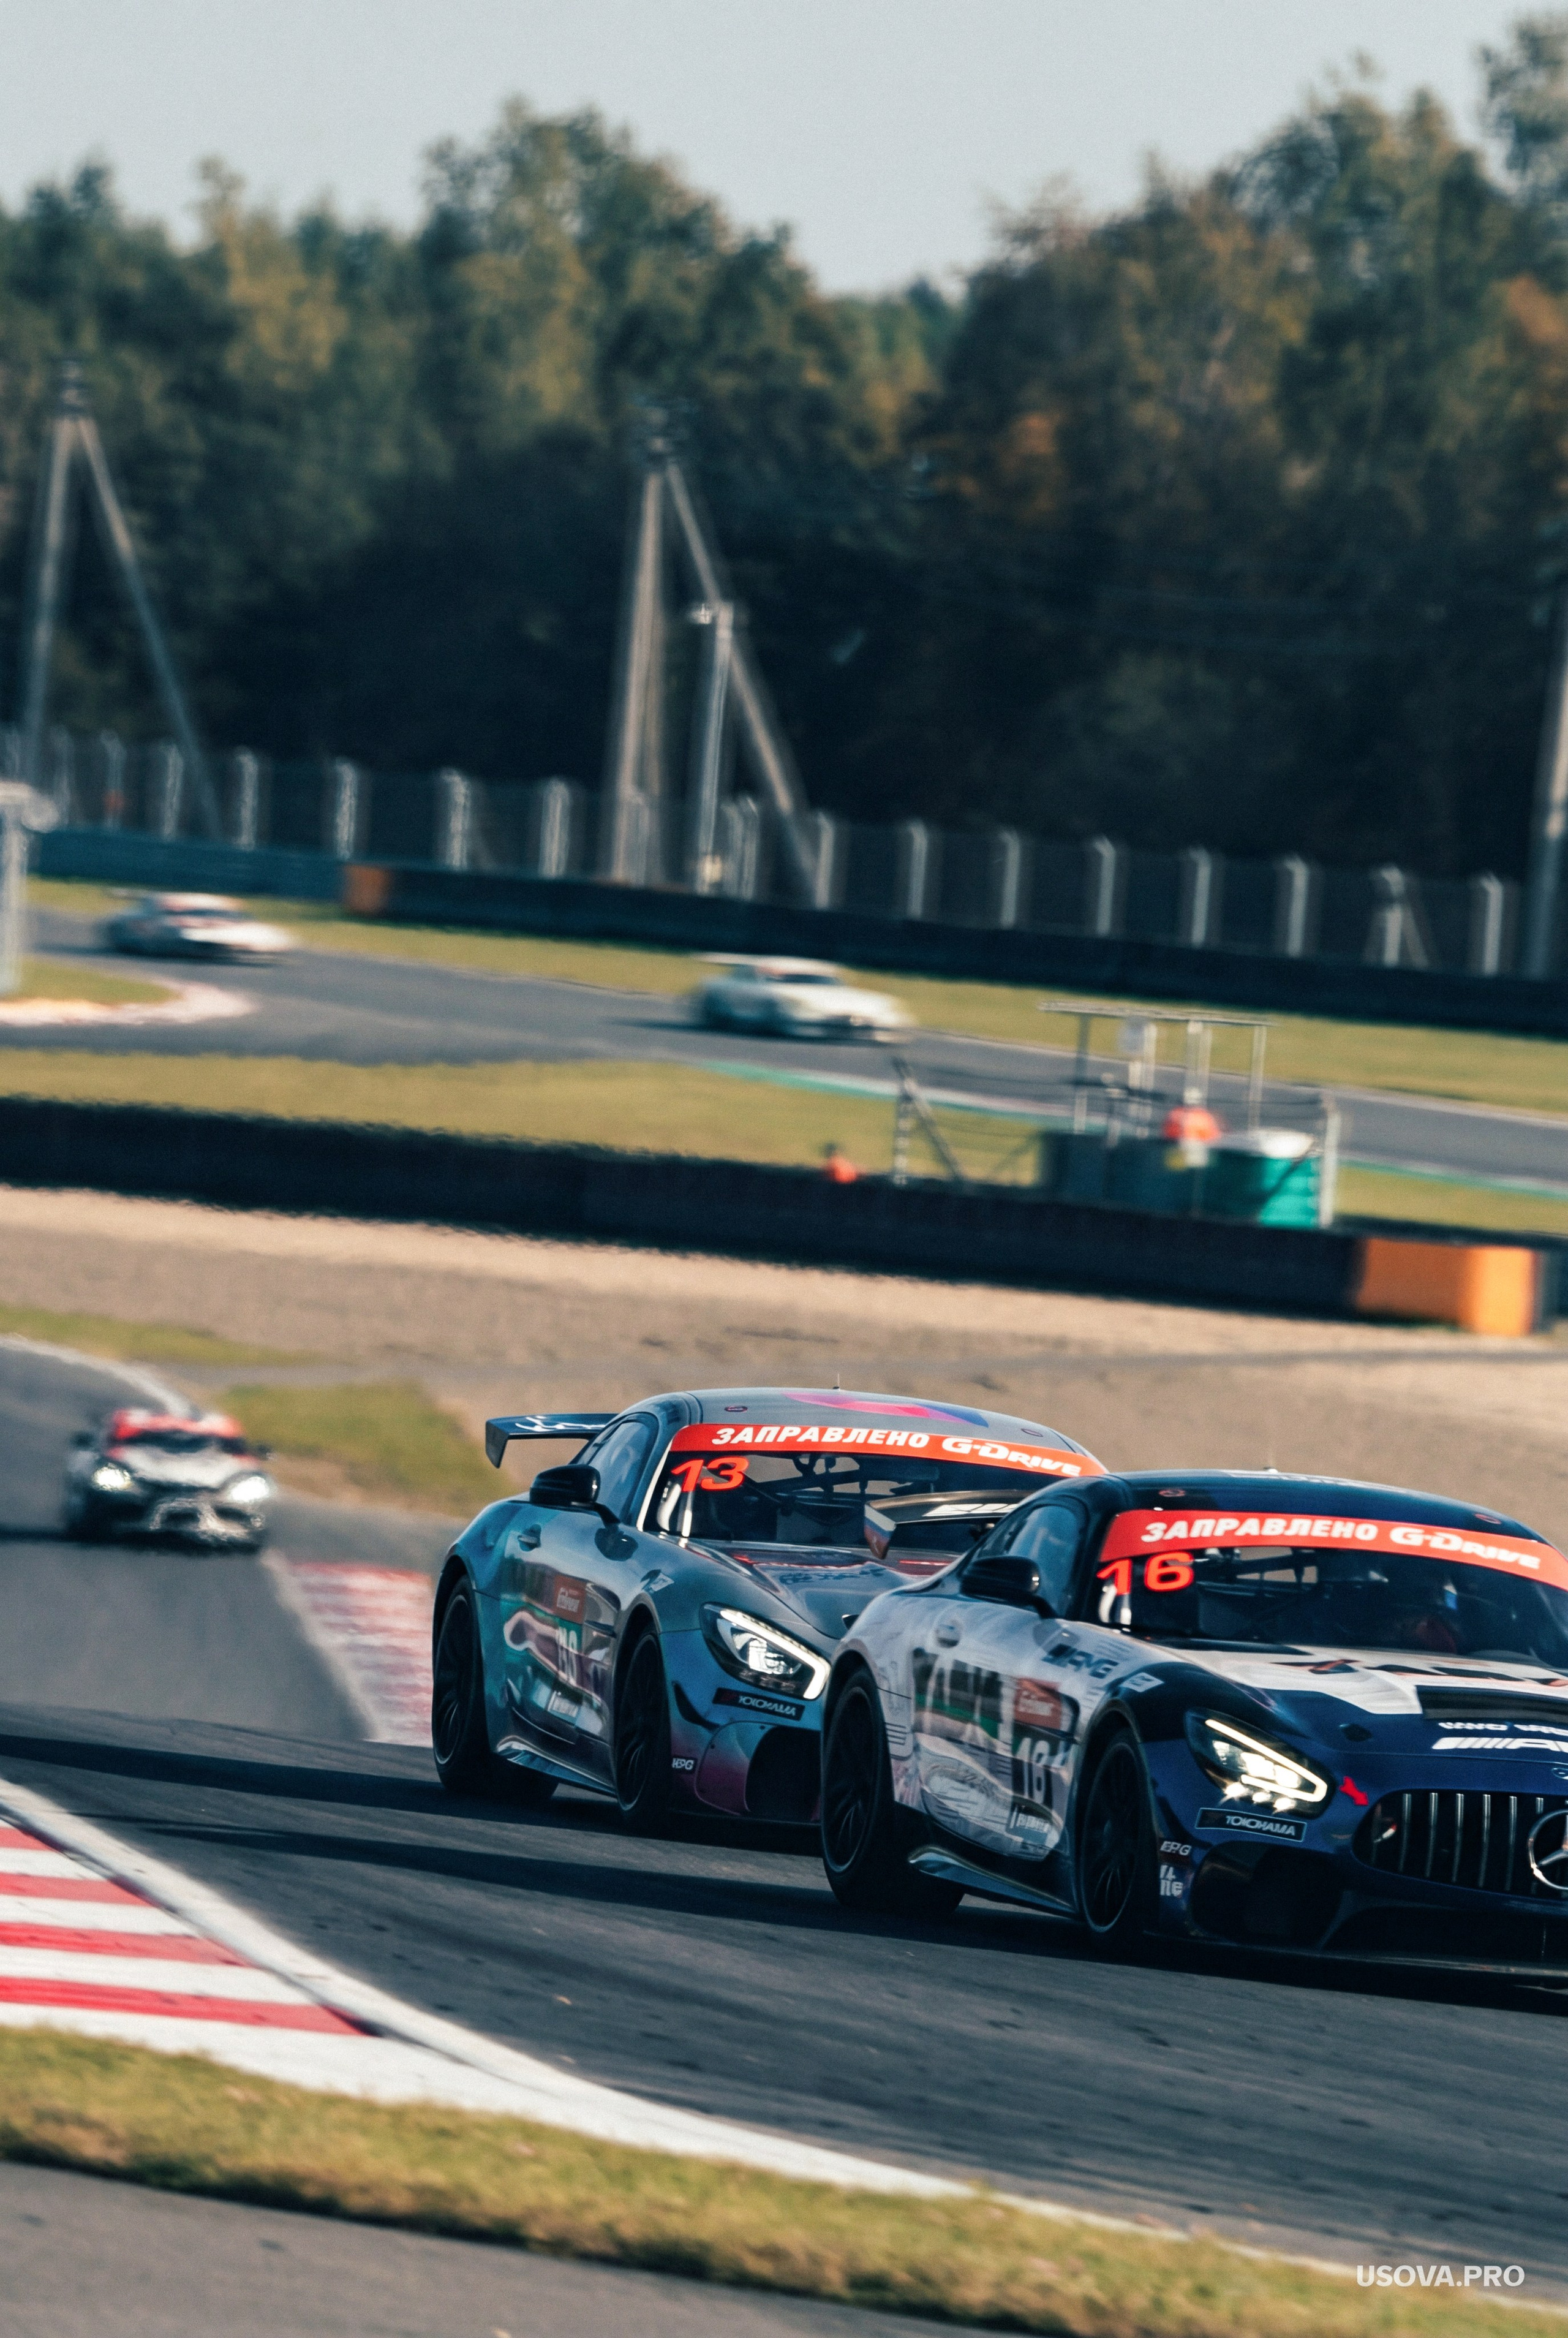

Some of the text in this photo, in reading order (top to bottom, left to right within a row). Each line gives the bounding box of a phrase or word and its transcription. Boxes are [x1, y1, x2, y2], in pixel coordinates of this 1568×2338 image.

[712, 1426, 930, 1448] ЗАПРАВЛЕНО
[671, 1456, 749, 1492] 13
[1141, 1518, 1378, 1542] ЗАПРАВЛЕНО
[1096, 1551, 1194, 1597] 16
[738, 1695, 797, 1716] YOKOHAMA
[1226, 1815, 1296, 1836] YOKOHAMA
